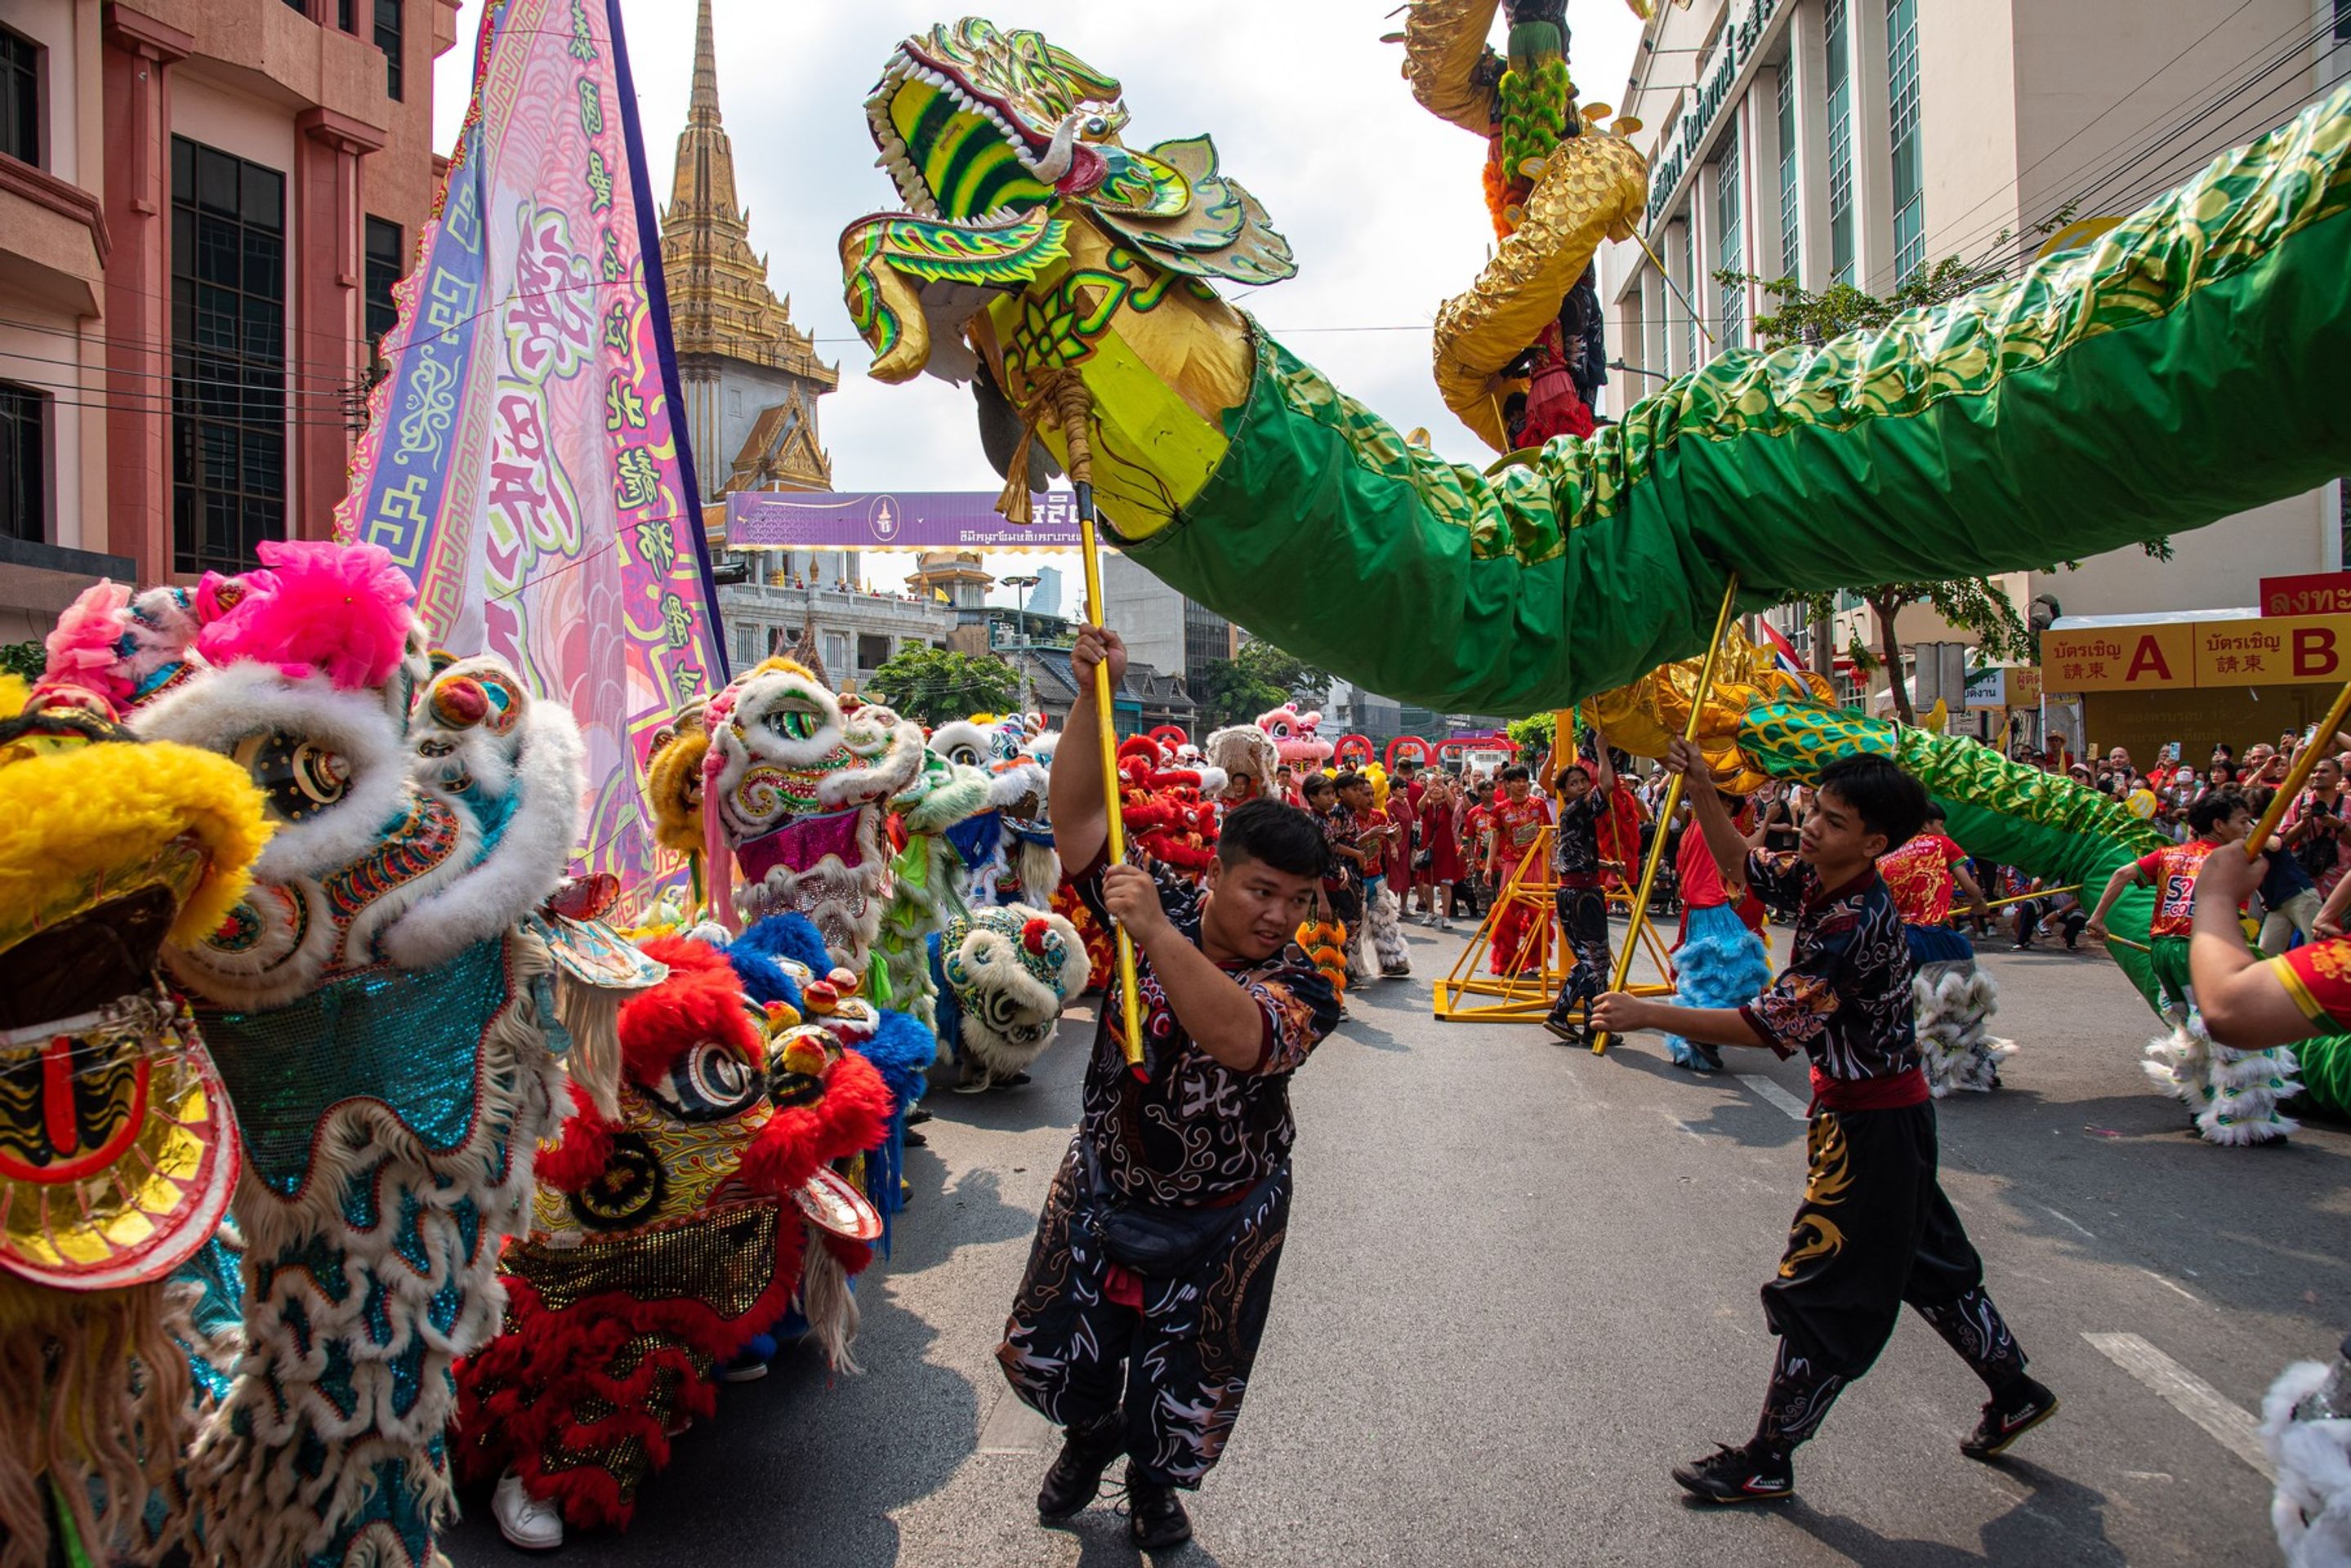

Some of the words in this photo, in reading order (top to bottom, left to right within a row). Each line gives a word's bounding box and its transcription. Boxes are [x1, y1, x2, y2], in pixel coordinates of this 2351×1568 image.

[2054, 639, 2121, 660] บัตรเชิญ
[2125, 635, 2173, 682] A
[2206, 632, 2281, 653] บัตรเชิญ
[2292, 628, 2340, 677] B
